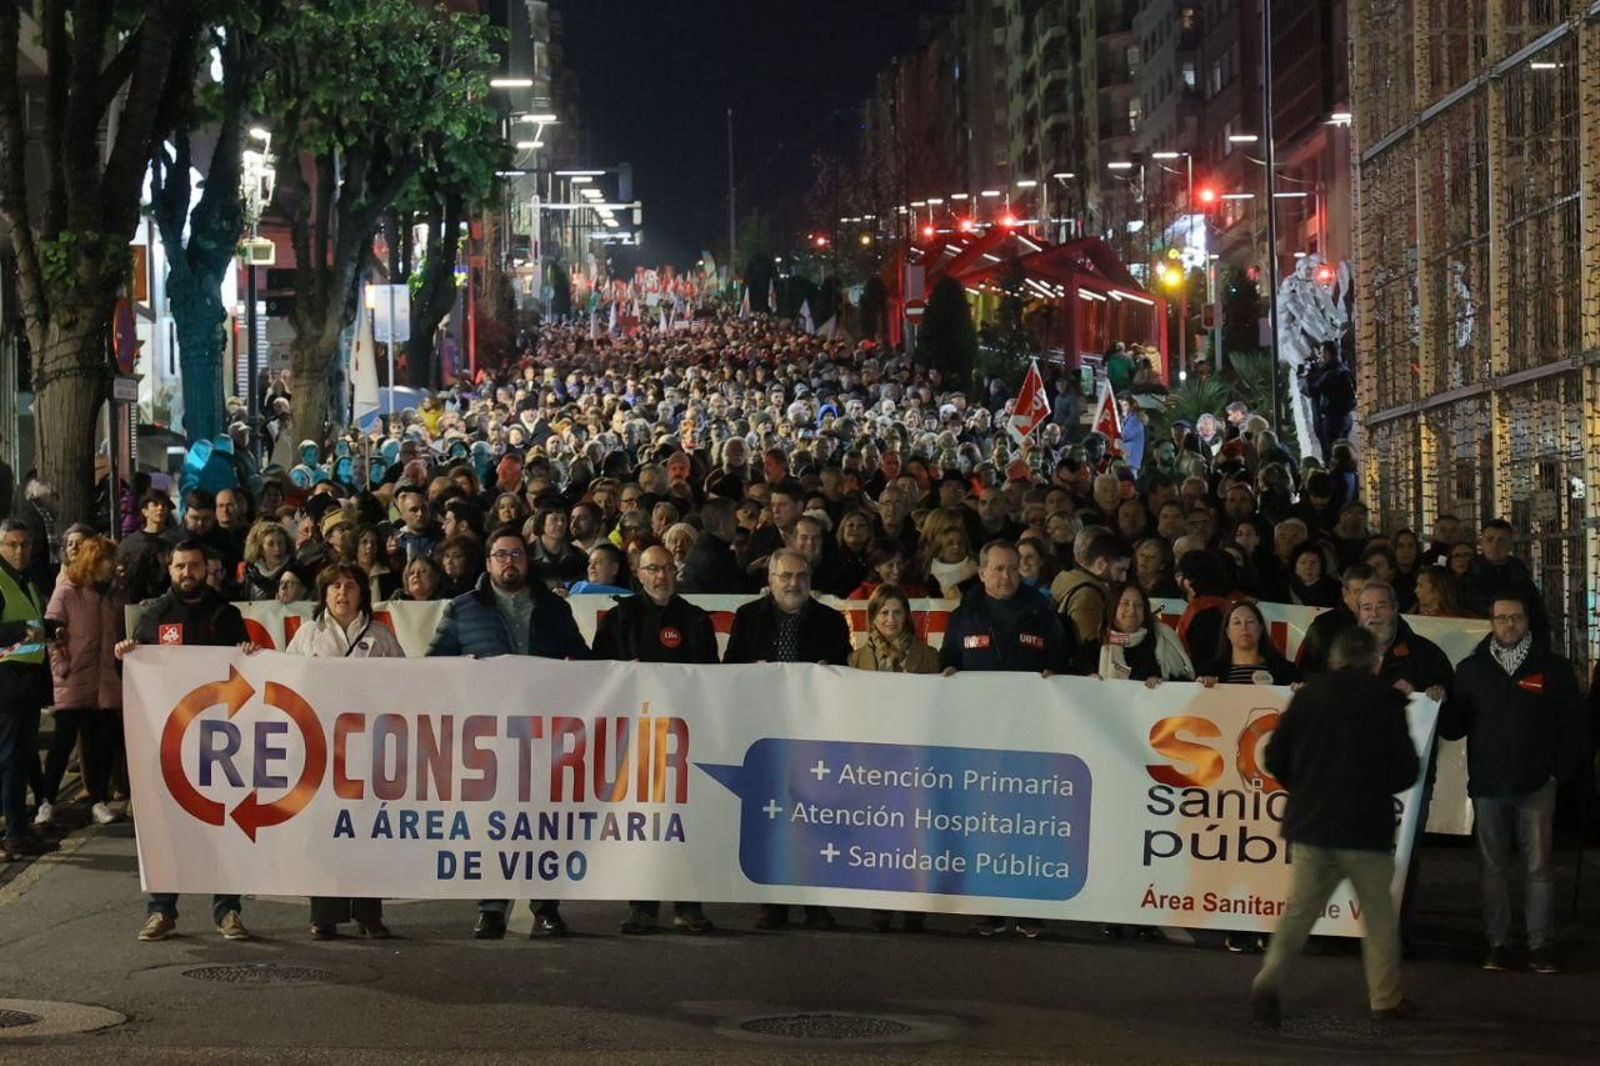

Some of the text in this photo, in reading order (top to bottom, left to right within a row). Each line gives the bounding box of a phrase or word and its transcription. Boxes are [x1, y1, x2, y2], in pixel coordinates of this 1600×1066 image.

[838, 763, 954, 791] Atención
[963, 769, 1075, 798] Primaria
[333, 802, 686, 844] A ÁREA SANITARIA
[791, 802, 905, 830] Atención
[914, 809, 1072, 841] Hospitalaria
[436, 850, 588, 882] DE VIGO
[848, 845, 967, 874] Sanidade
[976, 850, 1070, 880] Pública
[1141, 884, 1194, 912] Área
[1203, 891, 1292, 917] Sanitar
